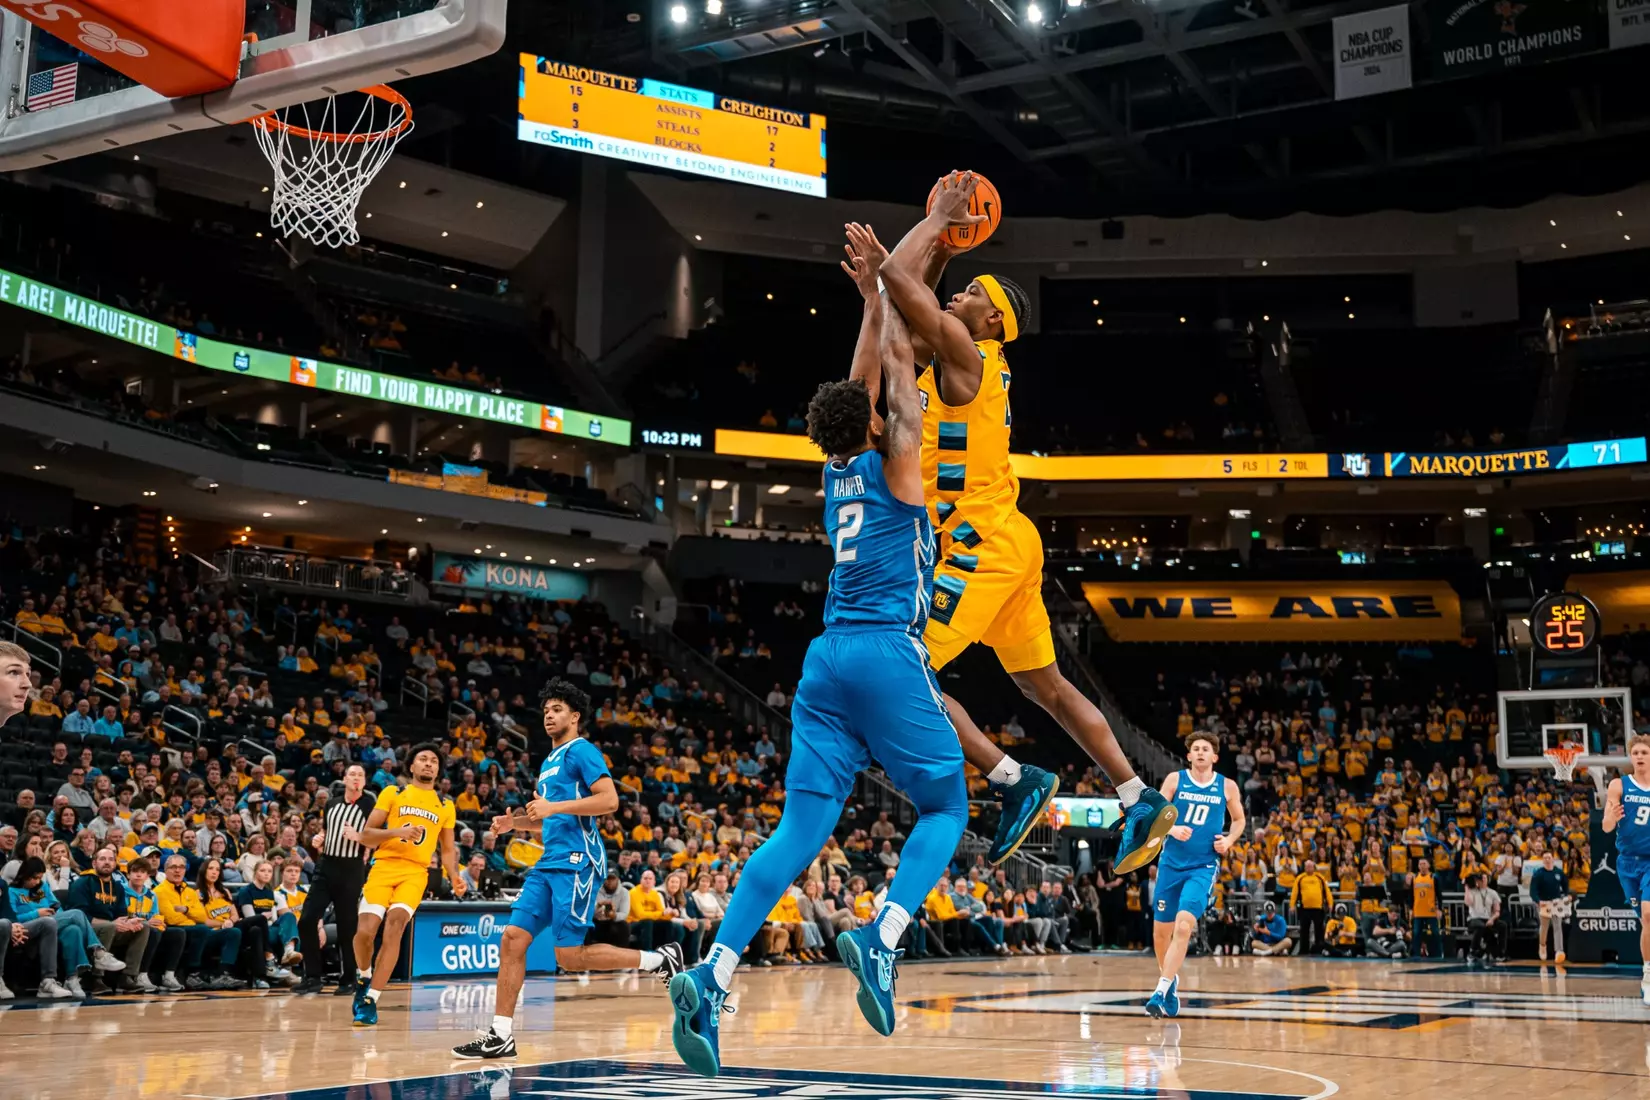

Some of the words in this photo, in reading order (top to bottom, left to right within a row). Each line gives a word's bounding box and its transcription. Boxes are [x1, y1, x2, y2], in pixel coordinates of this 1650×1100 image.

[1348, 31, 1369, 47] NBA
[1371, 26, 1393, 41] CUP
[1443, 43, 1493, 66] WORLD
[1497, 25, 1583, 56] CHAMPIONS
[1340, 39, 1403, 62] CHAMPIONS
[545, 60, 637, 92] MARQUETTE
[659, 86, 698, 103] STATS
[569, 85, 583, 96] 15
[656, 103, 702, 121] ASSISTS
[766, 125, 779, 137] 17
[720, 97, 804, 126] CREIGHTON
[572, 102, 579, 113] 8
[656, 119, 700, 136] STEALS
[769, 142, 776, 152] 2
[572, 118, 579, 129] 3
[654, 135, 702, 153] BLOCKS
[769, 157, 776, 168] 2
[534, 129, 594, 150] raSmith
[597, 141, 669, 164] CREATIVITY
[675, 156, 726, 176] BEYOND
[730, 167, 813, 191] ENGINEERING
[0, 274, 11, 299] E
[17, 280, 55, 314] ARE!
[63, 295, 159, 348] MARQUETTE!
[335, 367, 372, 395] FIND
[379, 377, 418, 404] YOUR
[424, 386, 475, 415] HAPPY
[479, 393, 525, 424] PLACE
[642, 430, 679, 445] 10:23
[680, 432, 702, 448] PM
[1223, 459, 1233, 473] 5
[1242, 460, 1258, 472] FLS
[1278, 459, 1288, 473] 2
[1409, 450, 1550, 477] MARQUETTE
[1593, 442, 1621, 464] 71
[833, 474, 865, 498] HARPER
[835, 501, 864, 564] 2
[485, 561, 549, 590] KONA
[1107, 597, 1237, 619] WE
[1269, 595, 1443, 619] ARE
[1551, 604, 1585, 621] 5:42
[1545, 620, 1584, 649] 25
[1178, 791, 1222, 805] CREIGHTON
[399, 805, 439, 825] MARQUETTE
[1184, 803, 1210, 826] 10
[1634, 805, 1650, 825] 9
[442, 925, 459, 935] ONE
[459, 925, 477, 935] CALL
[1578, 919, 1637, 932] GRUBER
[441, 943, 500, 970] GRUB
